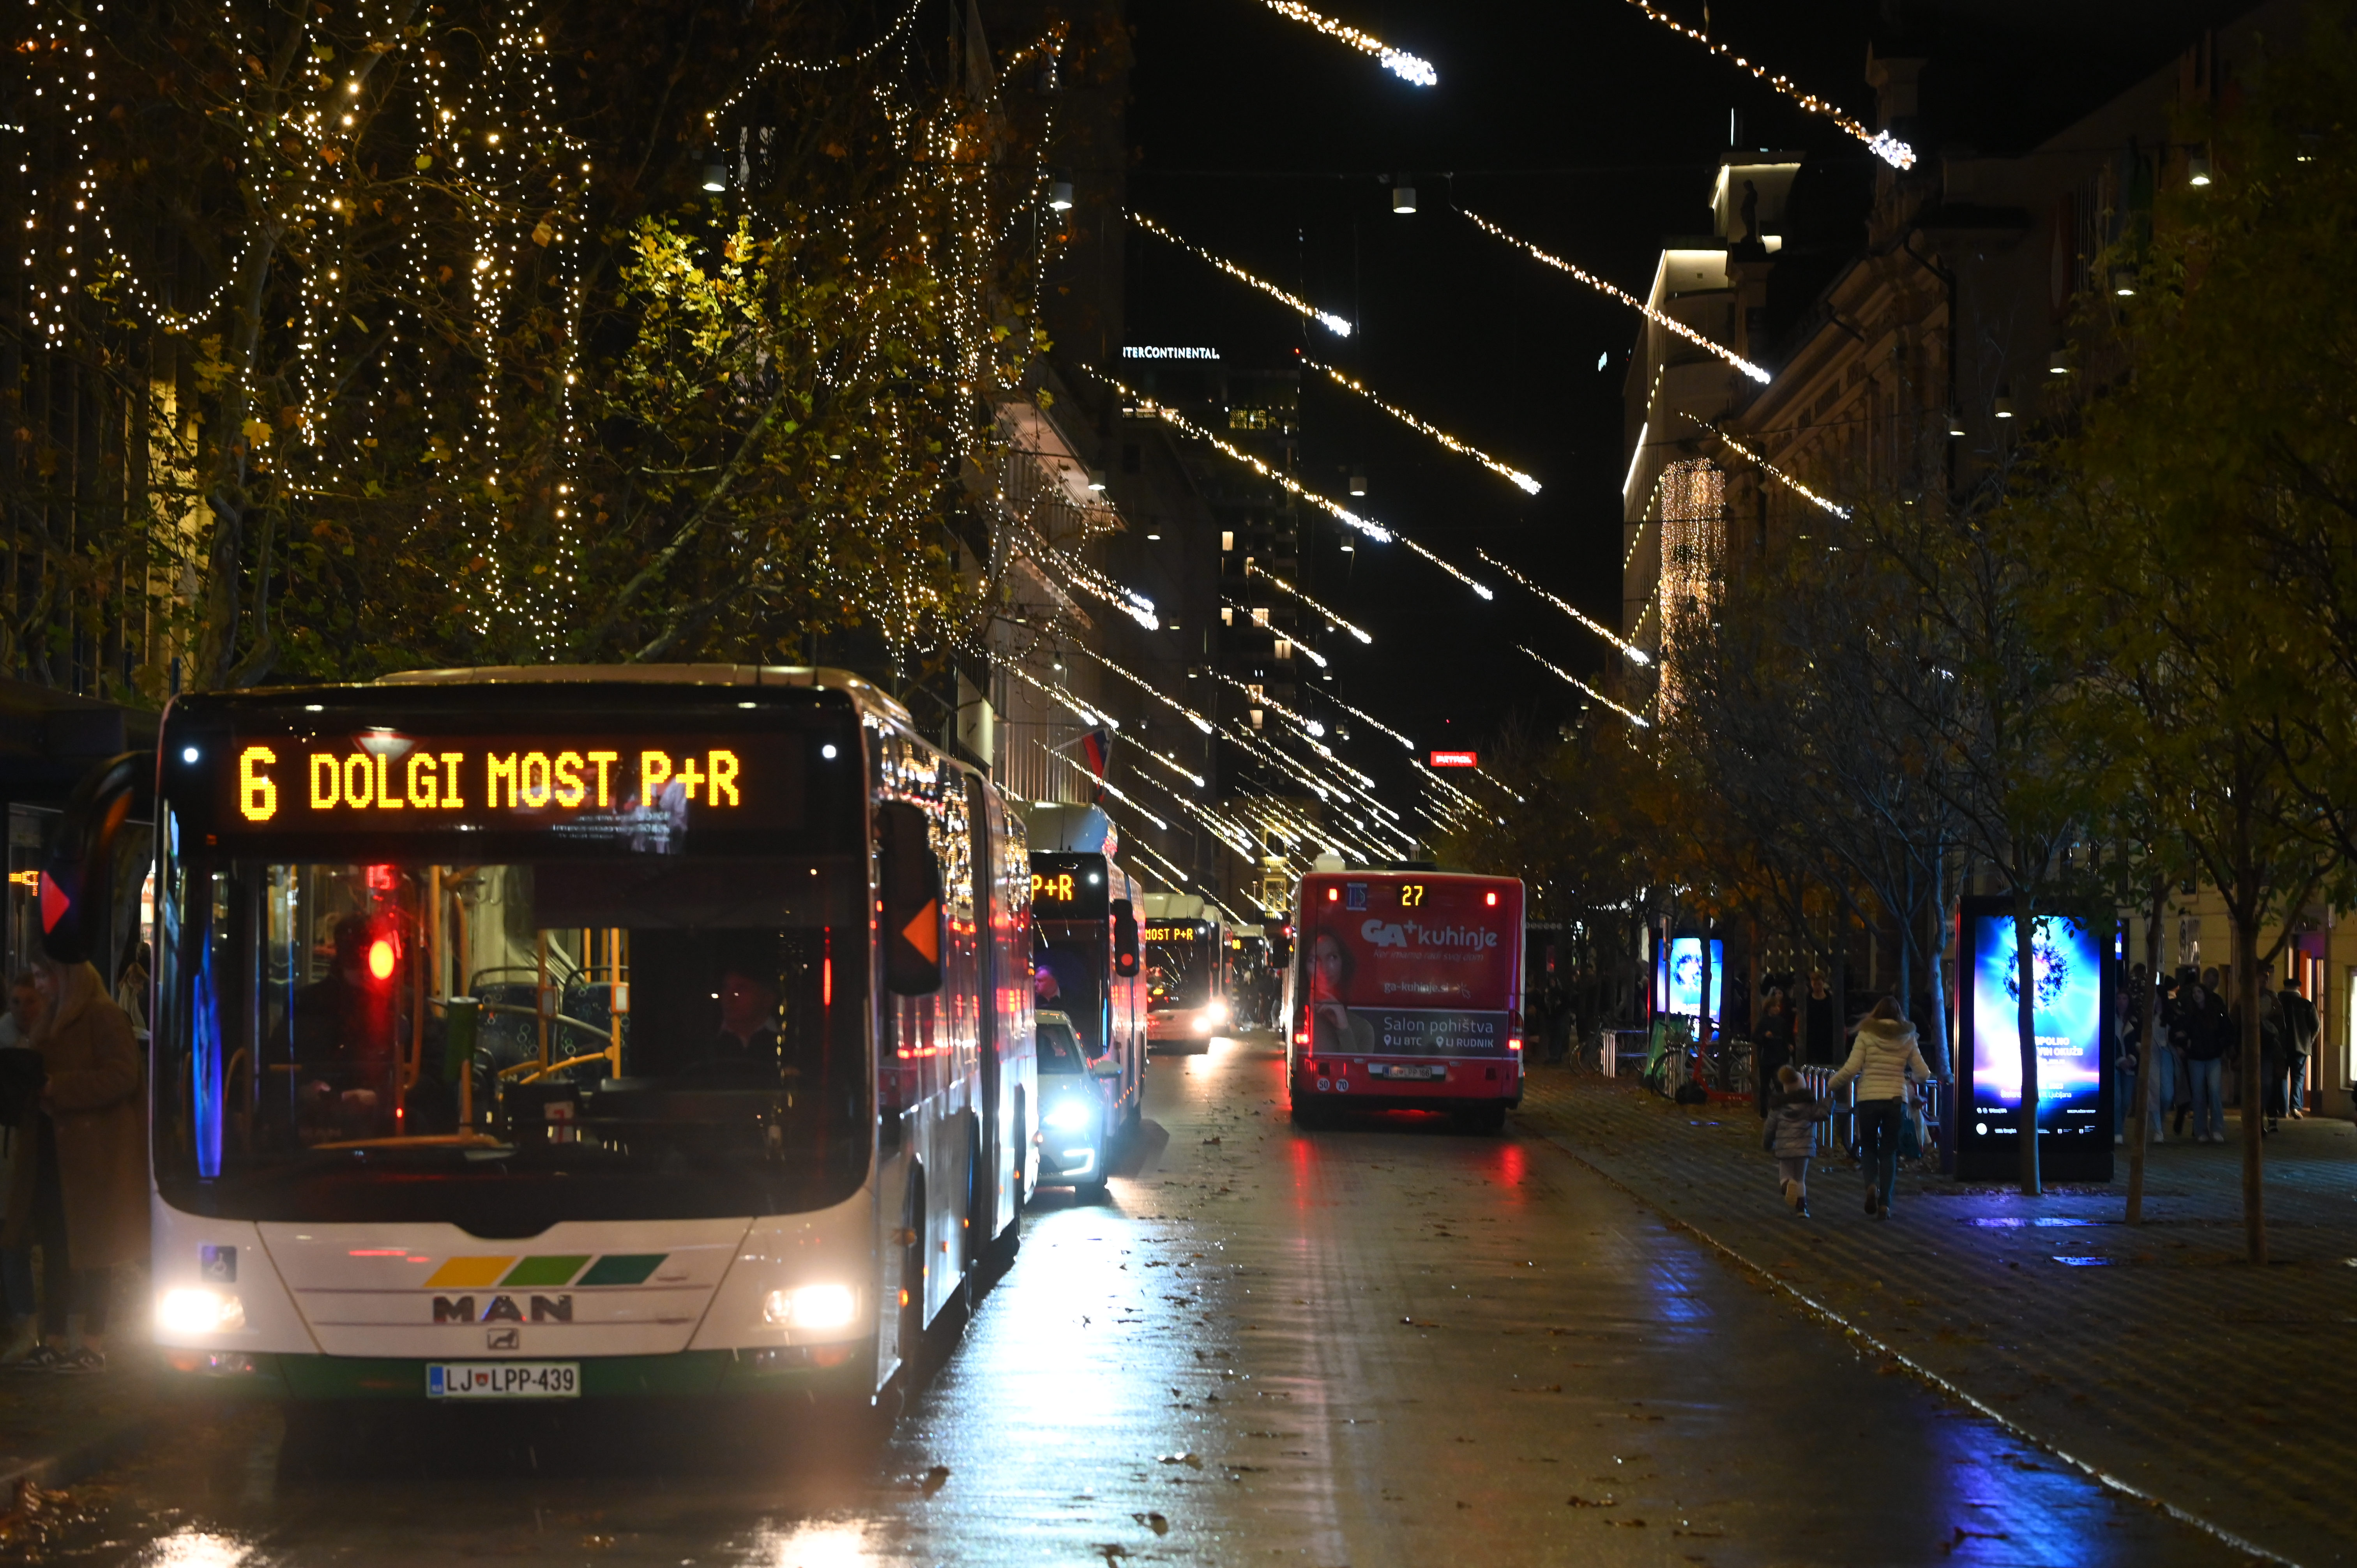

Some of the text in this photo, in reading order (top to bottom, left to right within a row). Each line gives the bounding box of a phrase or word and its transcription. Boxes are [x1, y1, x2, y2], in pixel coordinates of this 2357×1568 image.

[240, 747, 739, 820] 6 DOLGI MOST P+R
[1031, 874, 1072, 900] P+R
[1403, 885, 1422, 906] 27
[1145, 928, 1193, 940] MOST P+R
[1384, 982, 1449, 994] ga-kuhinje.si
[1384, 1017, 1494, 1035] Salon pohištva
[1404, 1037, 1422, 1046] BTC
[1456, 1038, 1494, 1048] RUDNIK
[2053, 1046, 2083, 1056] OKUŽB
[1319, 1080, 1328, 1088] 50
[1338, 1081, 1347, 1089] 70
[433, 1295, 572, 1323] MAN
[446, 1368, 574, 1392] LJ LPP-439
